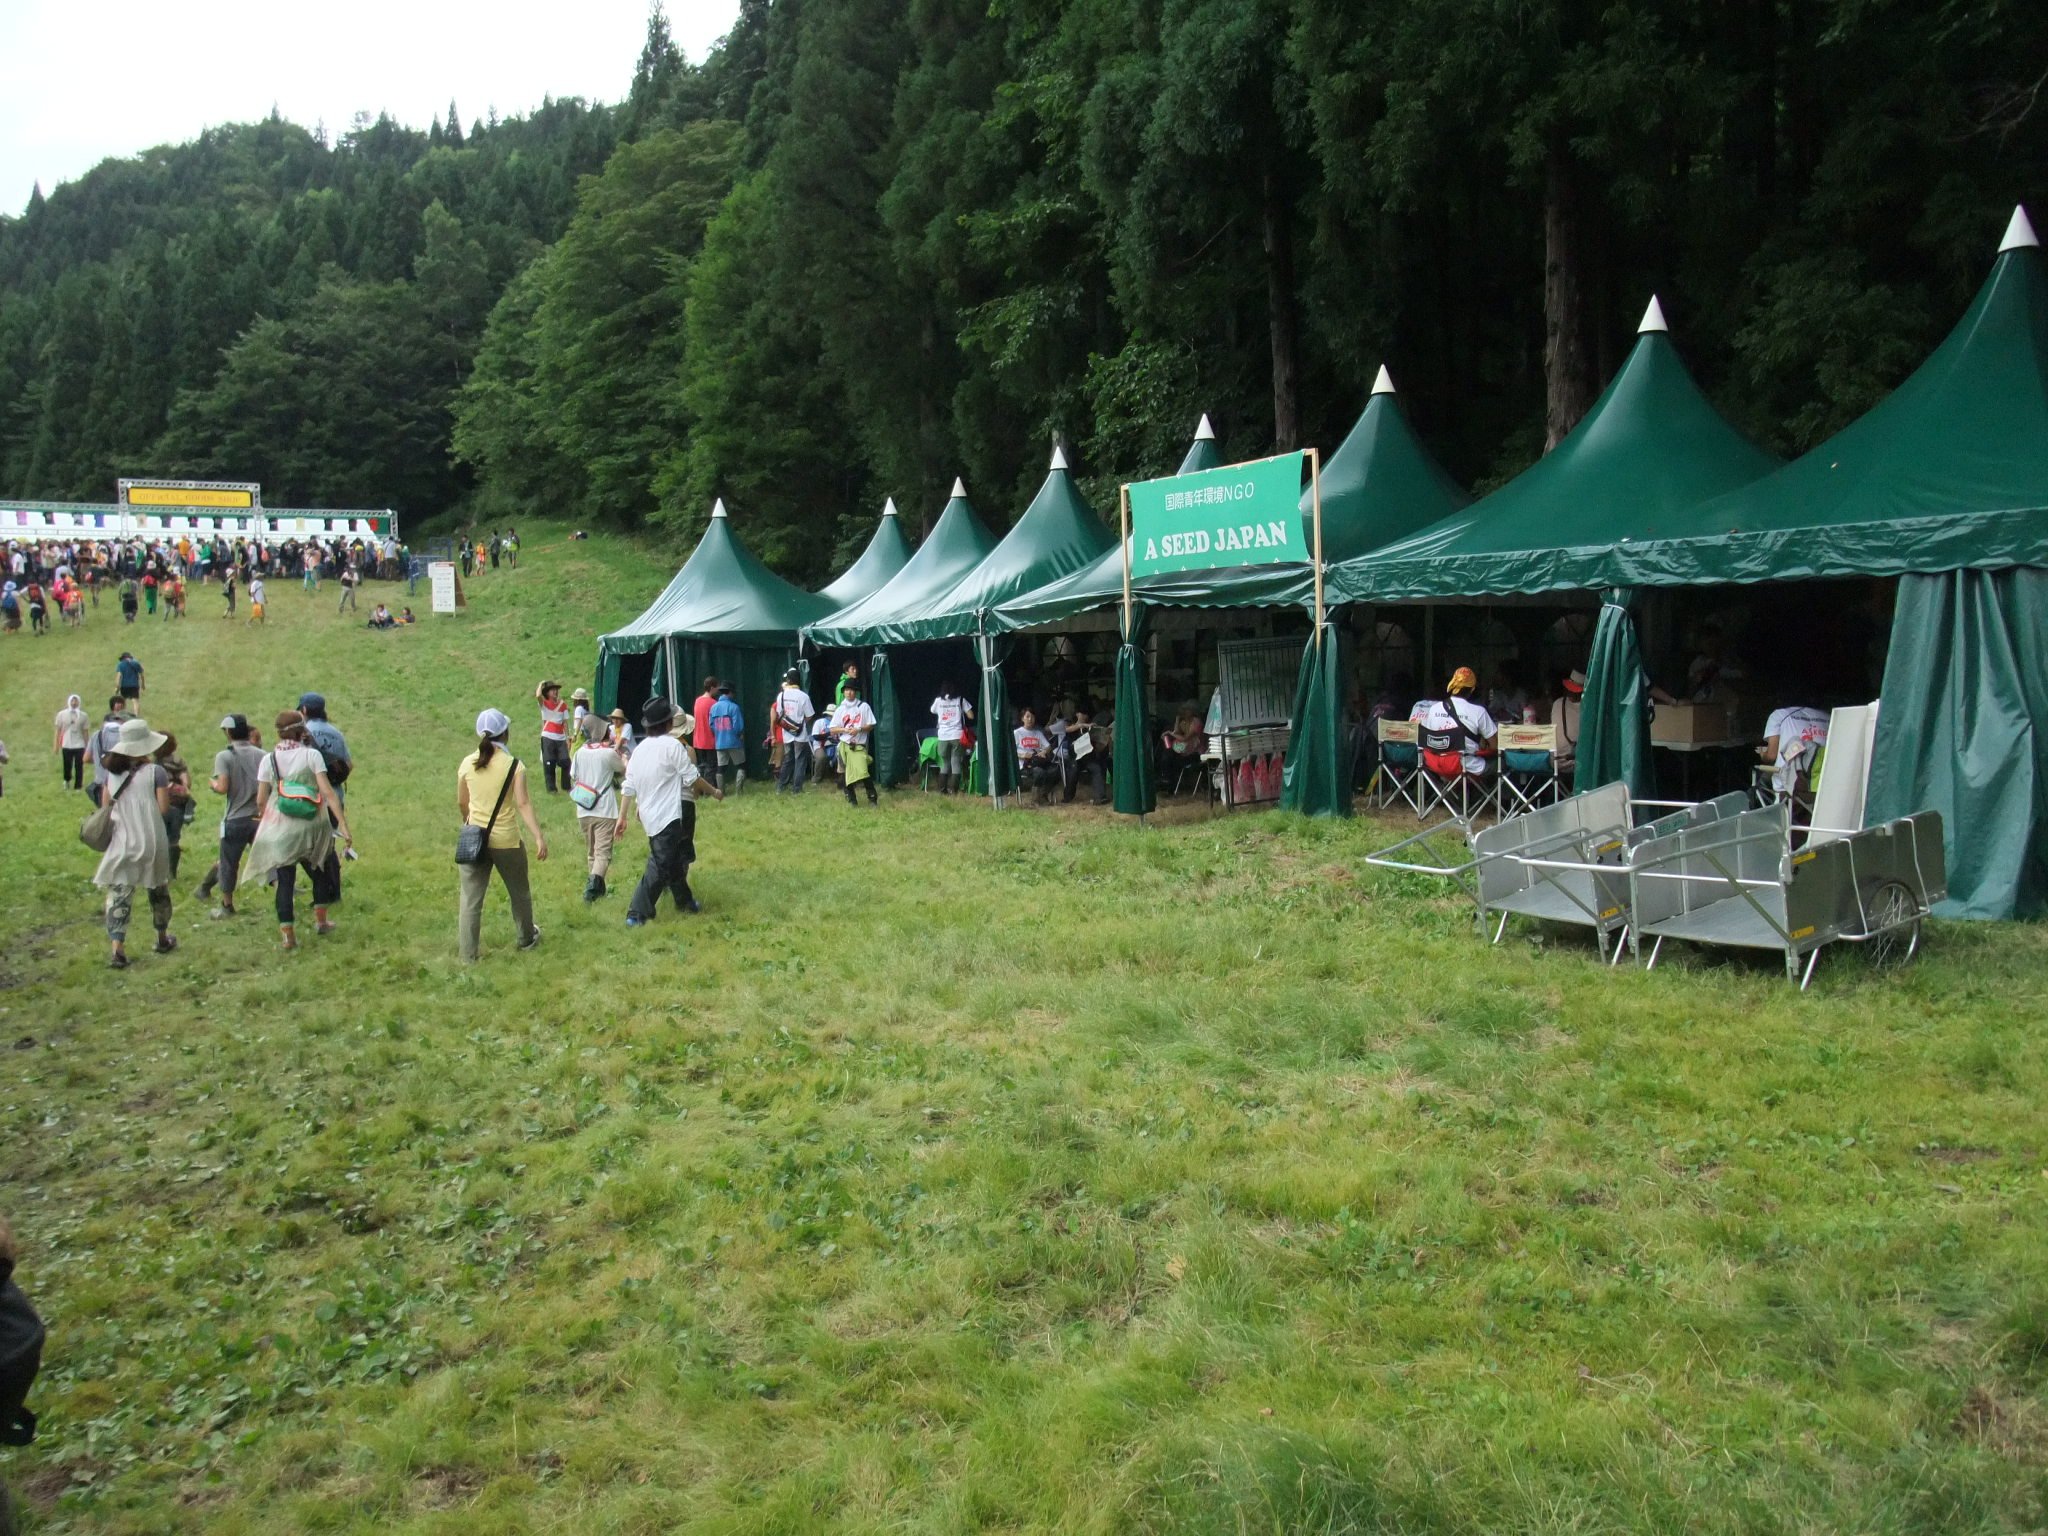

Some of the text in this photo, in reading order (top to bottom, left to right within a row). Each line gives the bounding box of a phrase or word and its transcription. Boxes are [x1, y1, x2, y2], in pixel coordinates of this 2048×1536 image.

[1165, 482, 1254, 511] 国際青年環境NGO
[1144, 521, 1287, 560] A SEED JAPAN
